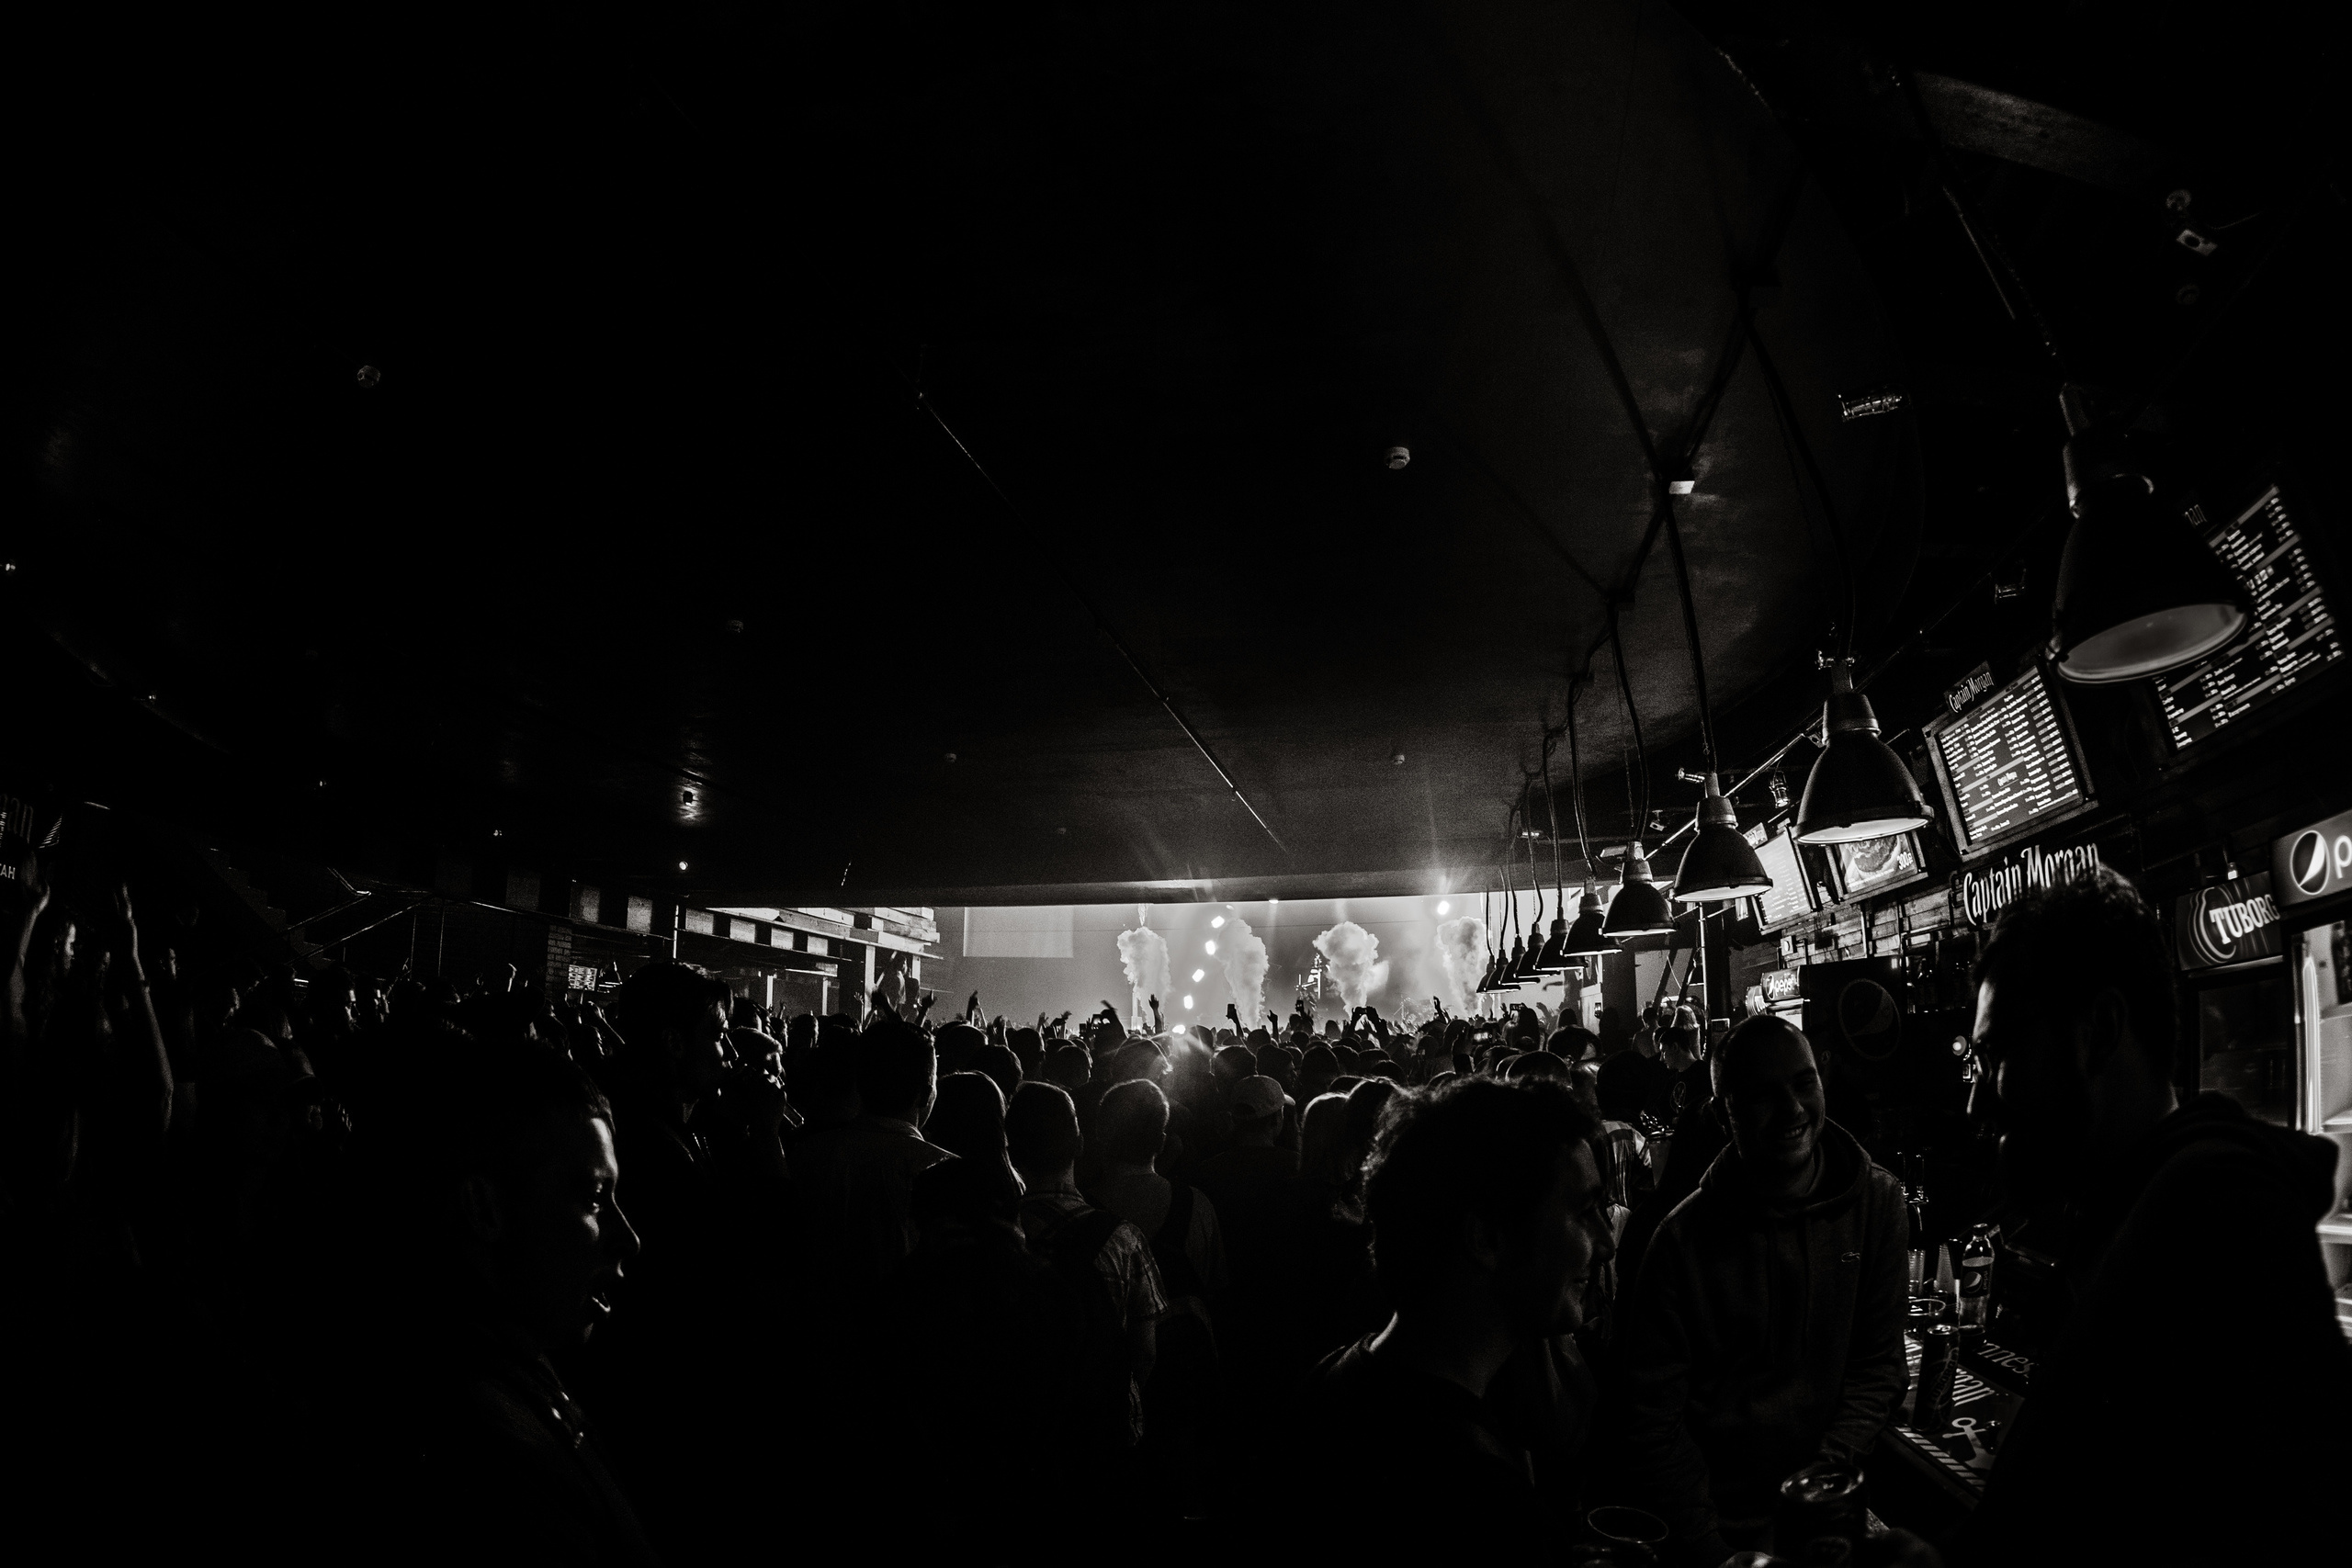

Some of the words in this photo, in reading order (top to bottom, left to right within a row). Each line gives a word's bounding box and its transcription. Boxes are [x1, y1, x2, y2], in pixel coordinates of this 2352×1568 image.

[1949, 684, 1971, 713] Captain
[1966, 671, 1995, 701] Morgan
[1963, 856, 2021, 926] Captain
[2020, 843, 2100, 891] Morgan
[2209, 894, 2280, 944] TUBORG
